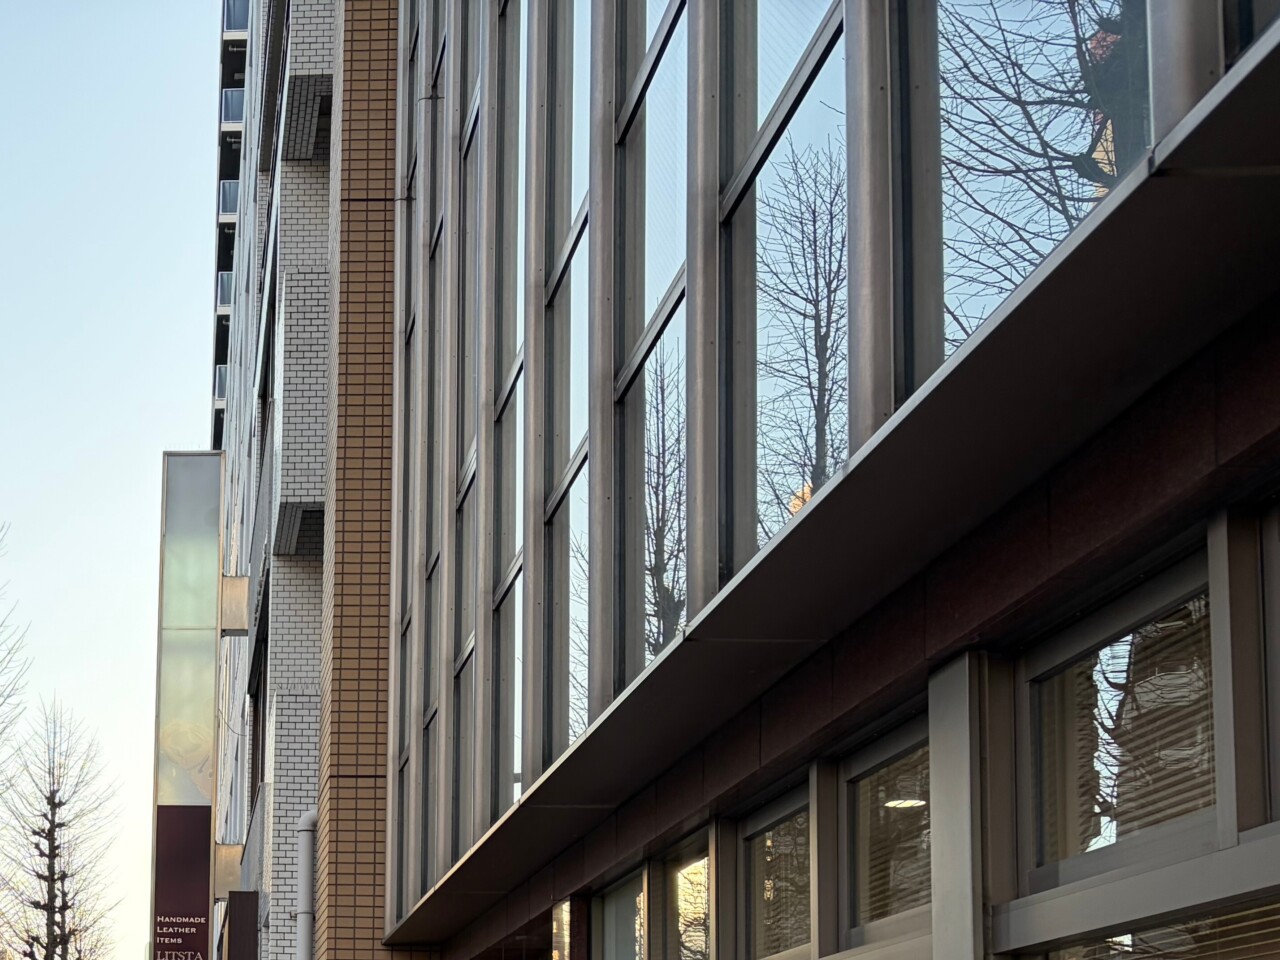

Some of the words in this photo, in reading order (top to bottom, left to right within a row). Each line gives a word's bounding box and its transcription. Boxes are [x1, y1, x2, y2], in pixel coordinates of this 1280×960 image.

[156, 915, 206, 924] HANDMADE
[156, 926, 197, 934] LEATHER
[156, 936, 183, 944] ITEMS
